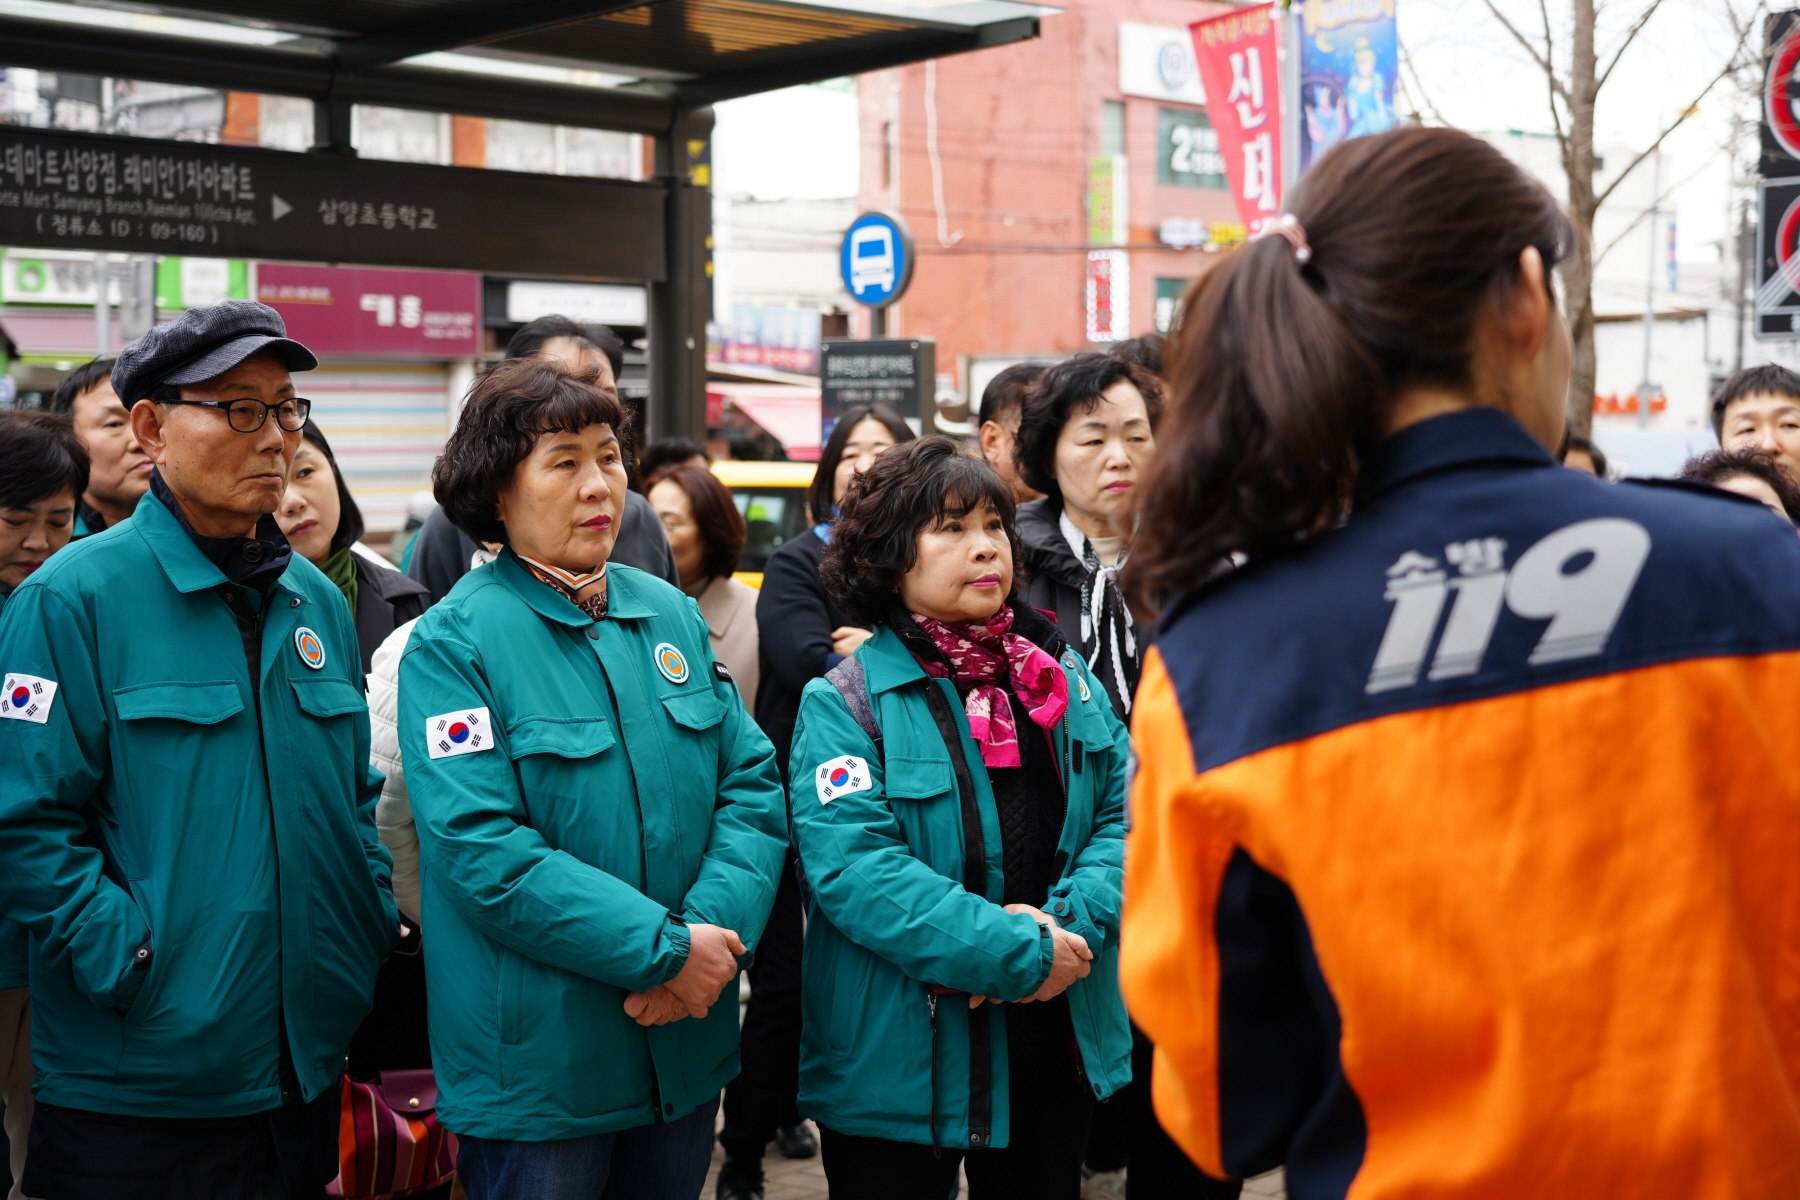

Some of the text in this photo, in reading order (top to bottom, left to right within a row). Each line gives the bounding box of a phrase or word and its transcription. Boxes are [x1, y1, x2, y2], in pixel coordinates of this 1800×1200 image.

[0, 143, 255, 201] 데마트삼양점.래미안1차아파트
[23, 190, 50, 209] Mart
[53, 192, 102, 216] Samyang
[317, 198, 438, 231] 삼양초등학교
[52, 214, 103, 236] 정류소
[111, 218, 130, 237] ID
[151, 221, 205, 242] 09-160
[1385, 536, 1507, 588] 소방
[1364, 517, 1651, 694] 119
